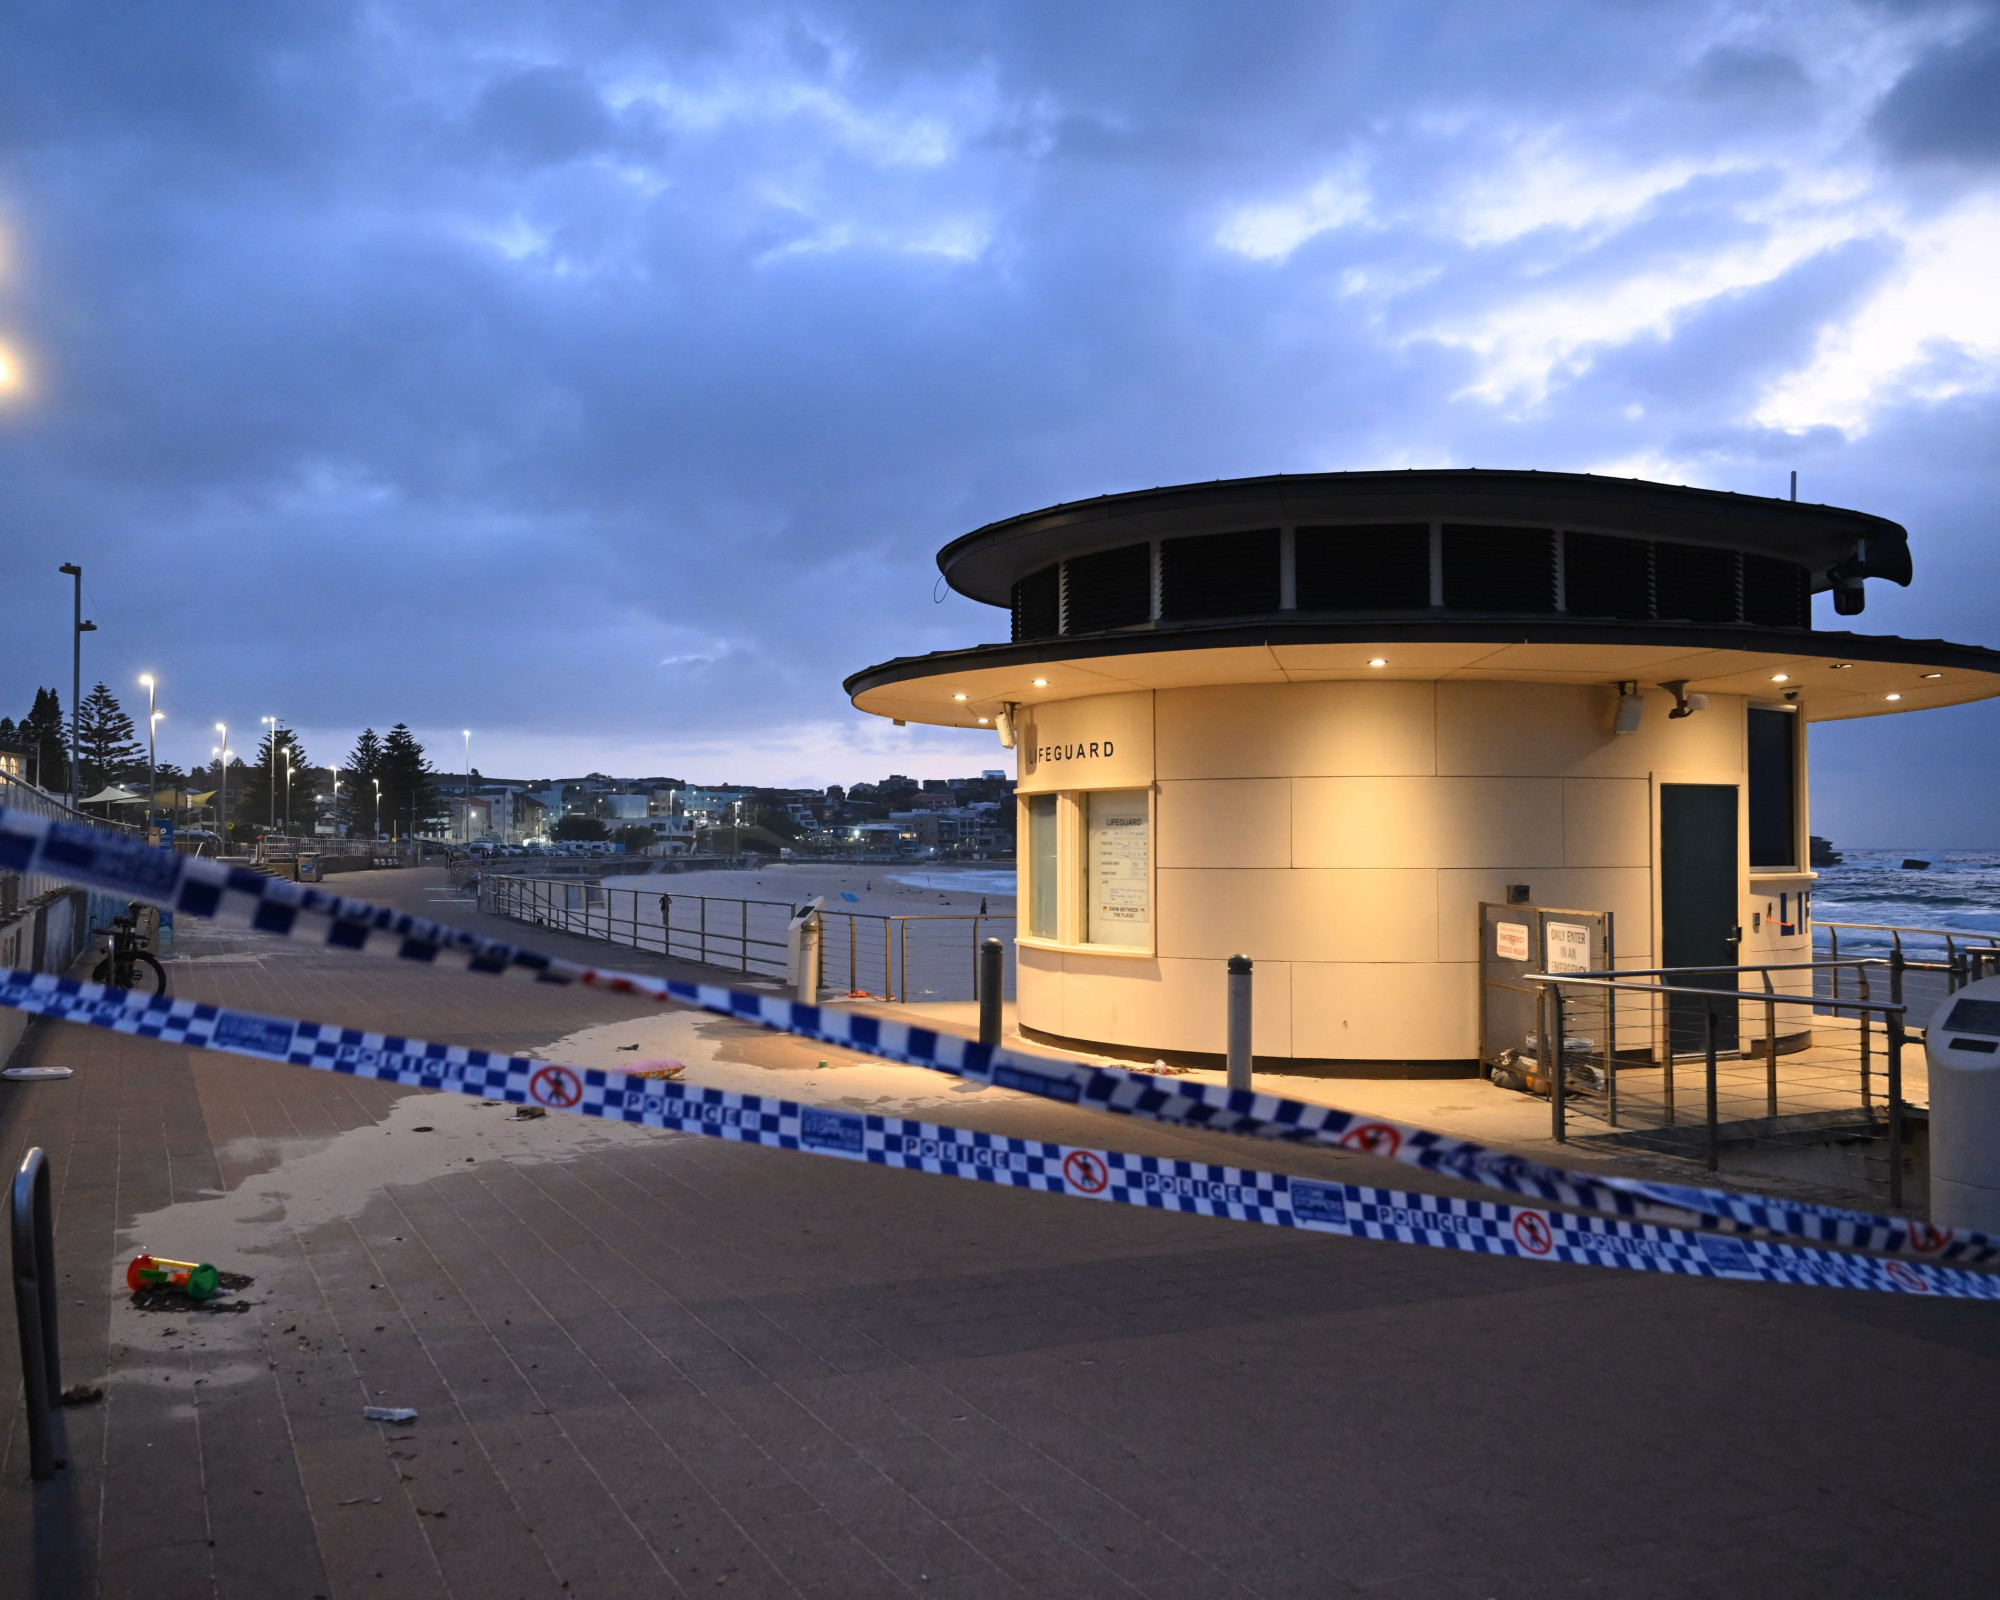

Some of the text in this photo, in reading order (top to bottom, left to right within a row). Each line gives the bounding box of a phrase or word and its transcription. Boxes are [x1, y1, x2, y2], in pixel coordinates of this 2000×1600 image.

[1029, 741, 1115, 765] LIFEGUARD
[1106, 818, 1142, 826] LIFEGUARD
[1551, 928, 1586, 945] ONLY ENTER
[1560, 946, 1577, 960] IN AN
[1551, 960, 1587, 973] EMERGENCY
[340, 1046, 460, 1081] POLICE
[627, 1093, 738, 1126] POLICE
[905, 1137, 1007, 1169] POLICE
[1145, 1175, 1240, 1203] POLICE
[1380, 1207, 1466, 1234] POLICE
[1582, 1233, 1663, 1257] POLICE
